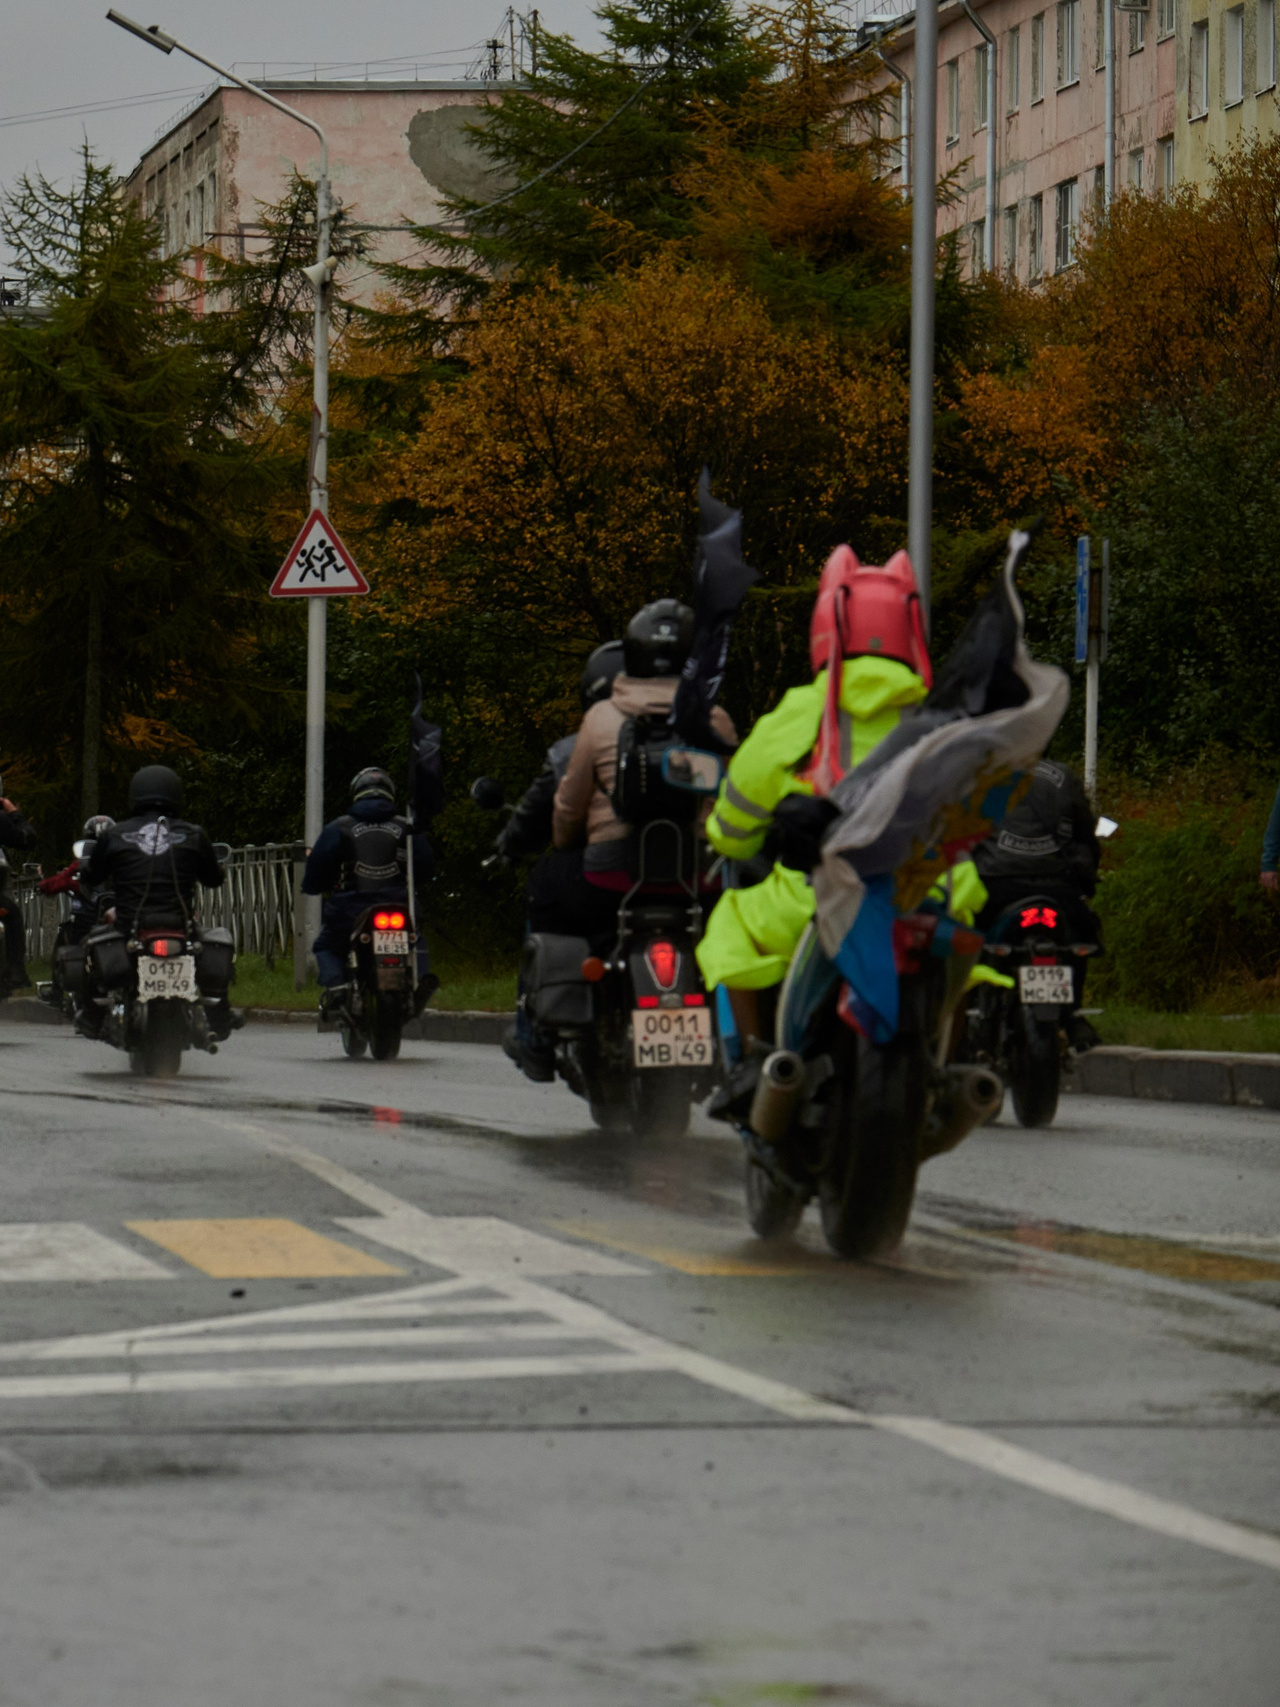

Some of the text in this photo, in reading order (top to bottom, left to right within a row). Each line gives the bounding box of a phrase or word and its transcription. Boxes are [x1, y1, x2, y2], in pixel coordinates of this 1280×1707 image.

[149, 962, 184, 975] 0137
[1027, 967, 1064, 981] 0119
[144, 979, 190, 992] MB 49
[1025, 988, 1070, 1000] MC 49
[645, 1014, 698, 1034] 0011
[638, 1043, 706, 1063] MB 49
